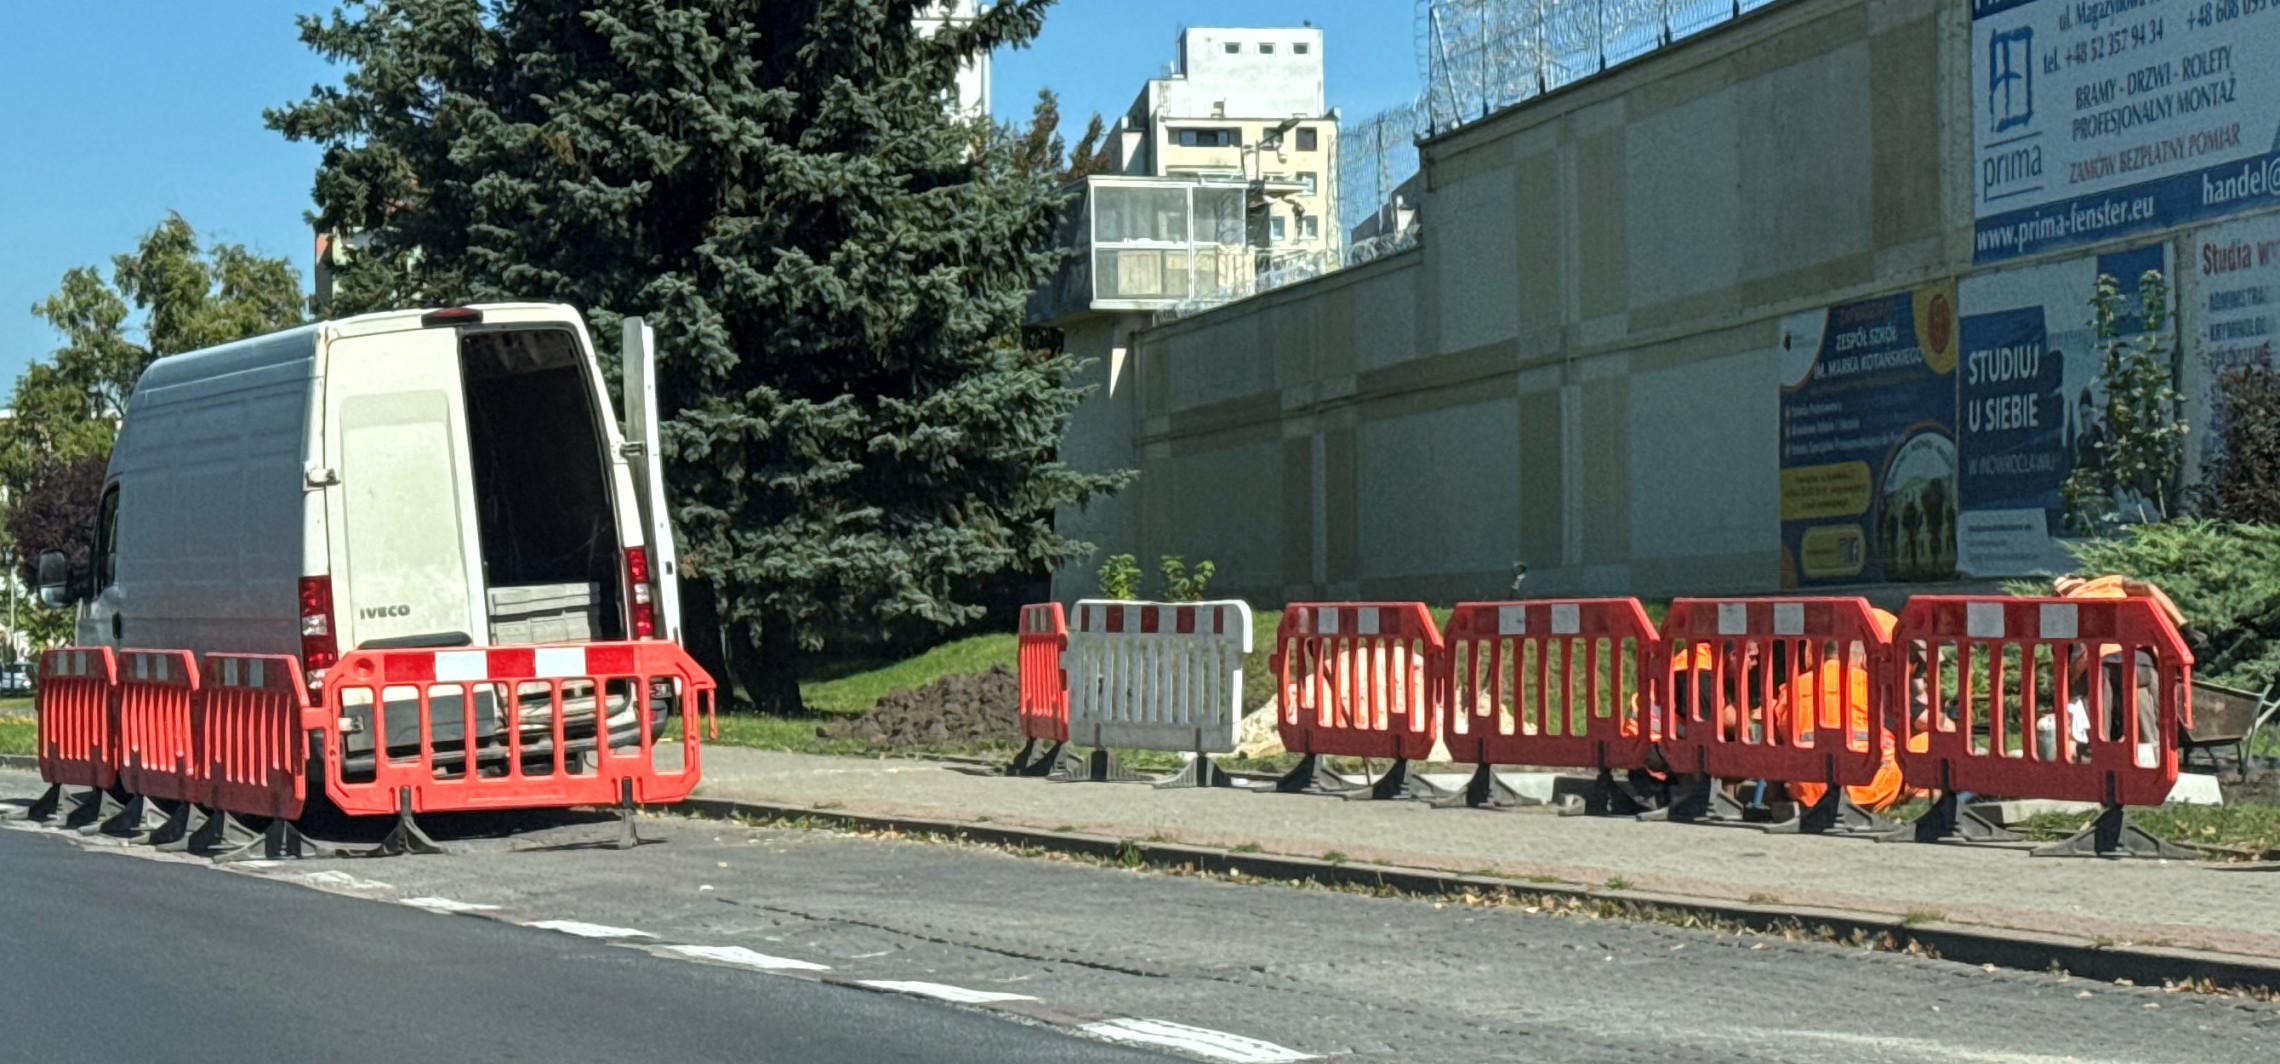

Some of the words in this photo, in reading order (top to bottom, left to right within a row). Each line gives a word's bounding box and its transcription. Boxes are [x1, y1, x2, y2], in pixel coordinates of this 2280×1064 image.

[2187, 2, 2212, 31] +48
[2043, 47, 2060, 75] tel.
[2065, 41, 2087, 67] +48
[2090, 36, 2104, 61] 52
[2107, 28, 2128, 56] 357
[2132, 24, 2146, 49] 94
[2149, 16, 2164, 44] 34
[2075, 78, 2116, 110] BRAMY
[2128, 61, 2171, 96] DRZWI
[2182, 46, 2232, 80] ROLETY
[2072, 94, 2174, 142] PROFESJONALNY
[2177, 71, 2237, 114] MONTAŻ
[1984, 144, 2042, 203] prima
[2069, 153, 2116, 184] ZAMÓW
[2119, 136, 2186, 172] BEZPŁATNY
[2188, 122, 2240, 157] POMIAR
[1977, 194, 2155, 252] www.prima-fenster.eu
[2203, 238, 2251, 276] Studia
[1836, 326, 1868, 352] ZESPÓŁ
[1869, 322, 1897, 344] SZKÓŁ
[1968, 344, 2040, 385] STUDIUJ
[1969, 399, 1981, 433] U
[1985, 393, 2039, 432] SIEBIE
[360, 605, 410, 619] IVECO
